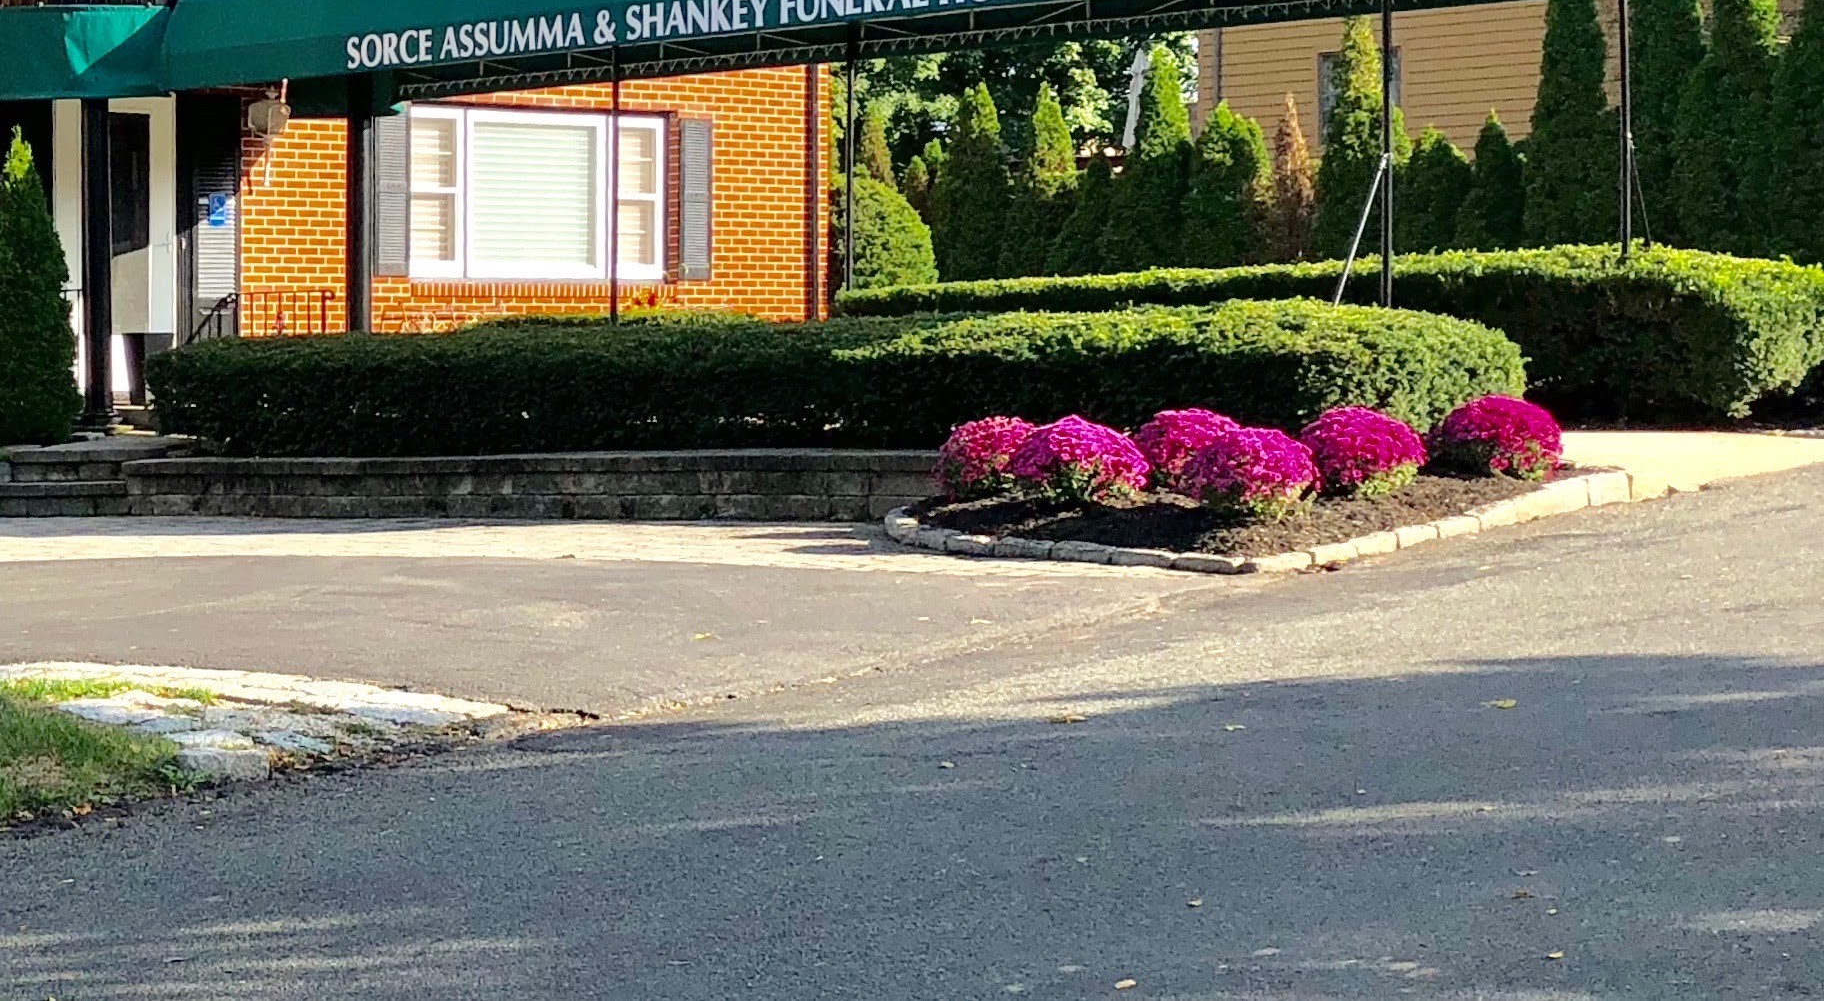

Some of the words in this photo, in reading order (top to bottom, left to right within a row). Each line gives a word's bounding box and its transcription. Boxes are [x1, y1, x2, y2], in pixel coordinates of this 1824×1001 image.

[346, 29, 433, 69] SORCE
[440, 12, 586, 60] ASSUMMA
[593, 9, 616, 45] &
